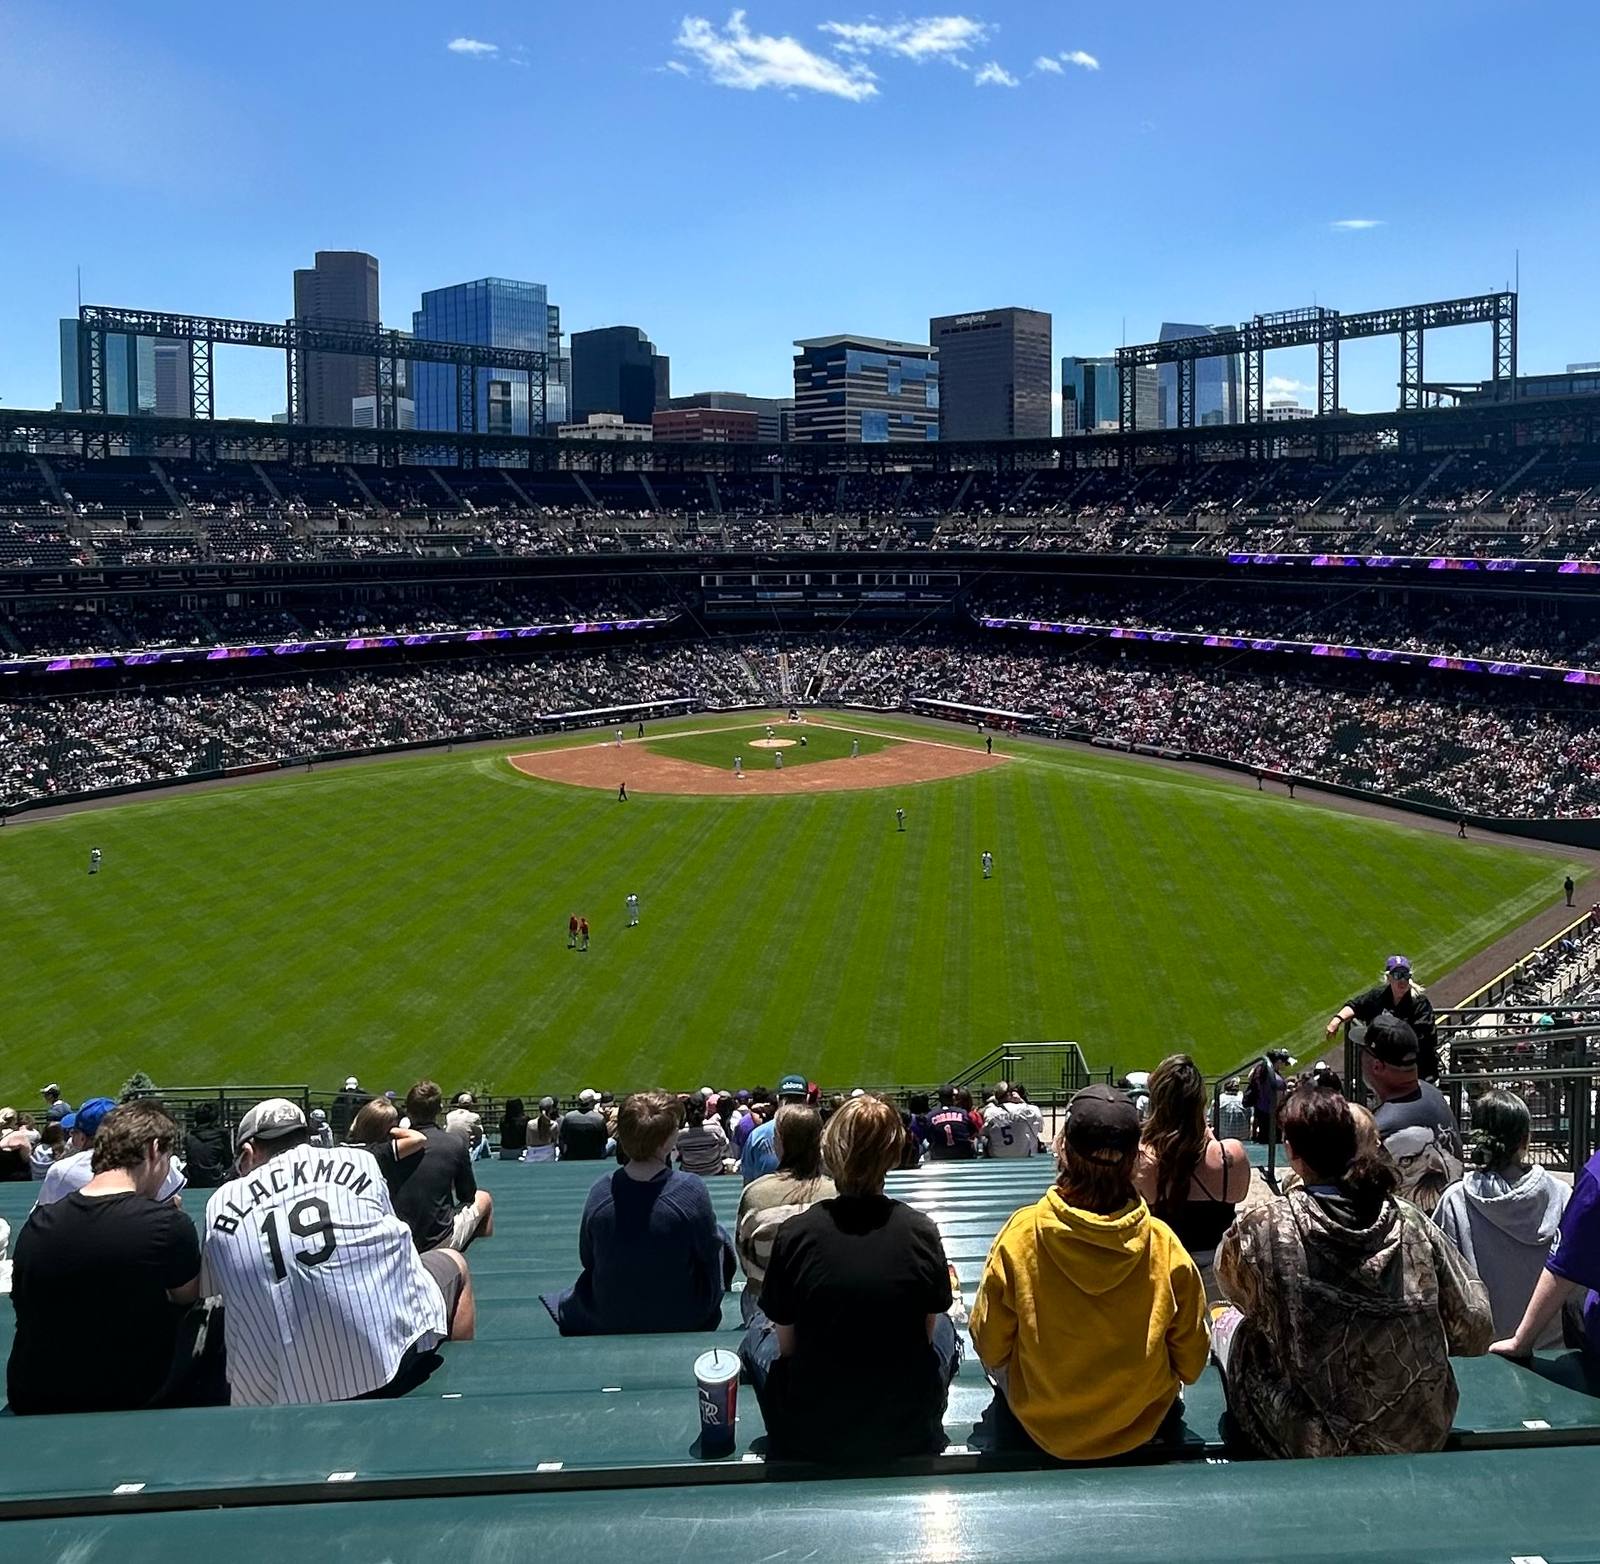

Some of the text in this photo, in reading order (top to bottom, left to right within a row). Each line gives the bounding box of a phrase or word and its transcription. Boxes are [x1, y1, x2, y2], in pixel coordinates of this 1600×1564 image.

[944, 1124, 955, 1146] 1
[1001, 1126, 1014, 1146] 5
[213, 1159, 372, 1236] BLACKMON
[261, 1196, 337, 1280] 19
